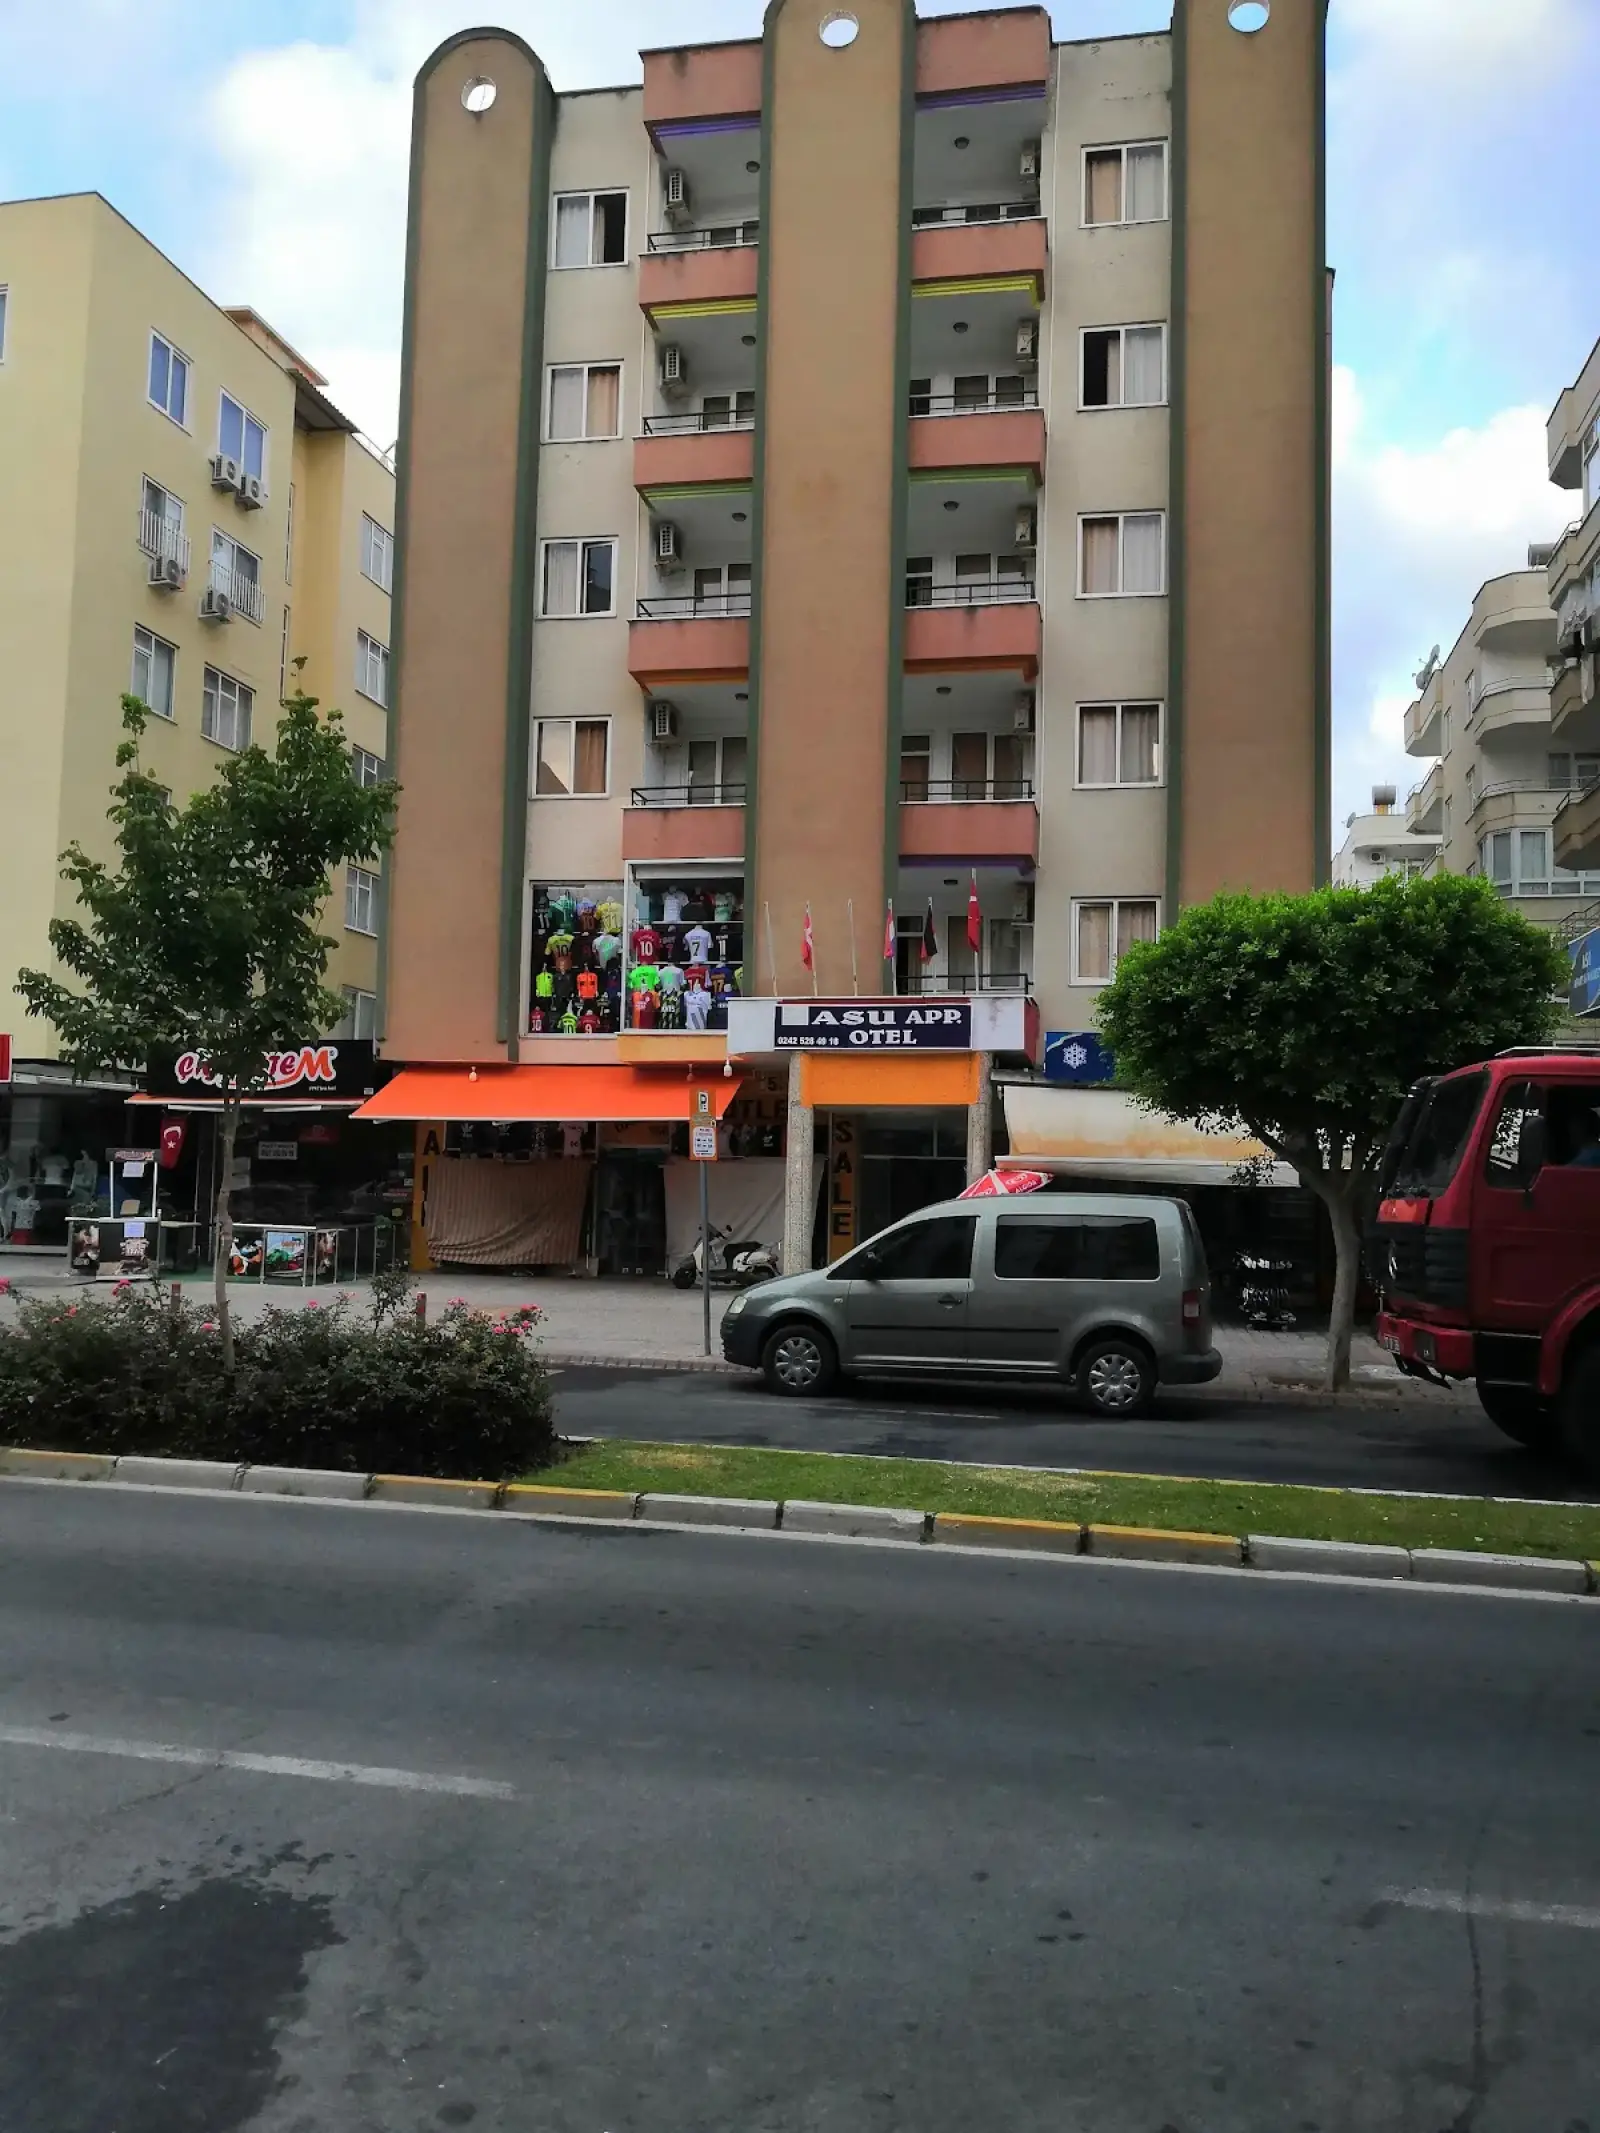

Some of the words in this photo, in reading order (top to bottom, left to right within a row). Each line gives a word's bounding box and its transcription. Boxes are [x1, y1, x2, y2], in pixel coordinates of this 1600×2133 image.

[639, 941, 653, 957] 10
[692, 941, 700, 956] 7
[811, 1009, 897, 1026] ASU
[905, 1009, 963, 1025] APP.
[777, 1036, 798, 1046] 0242
[849, 1028, 918, 1046] OTEL
[833, 1120, 853, 1236] SALE
